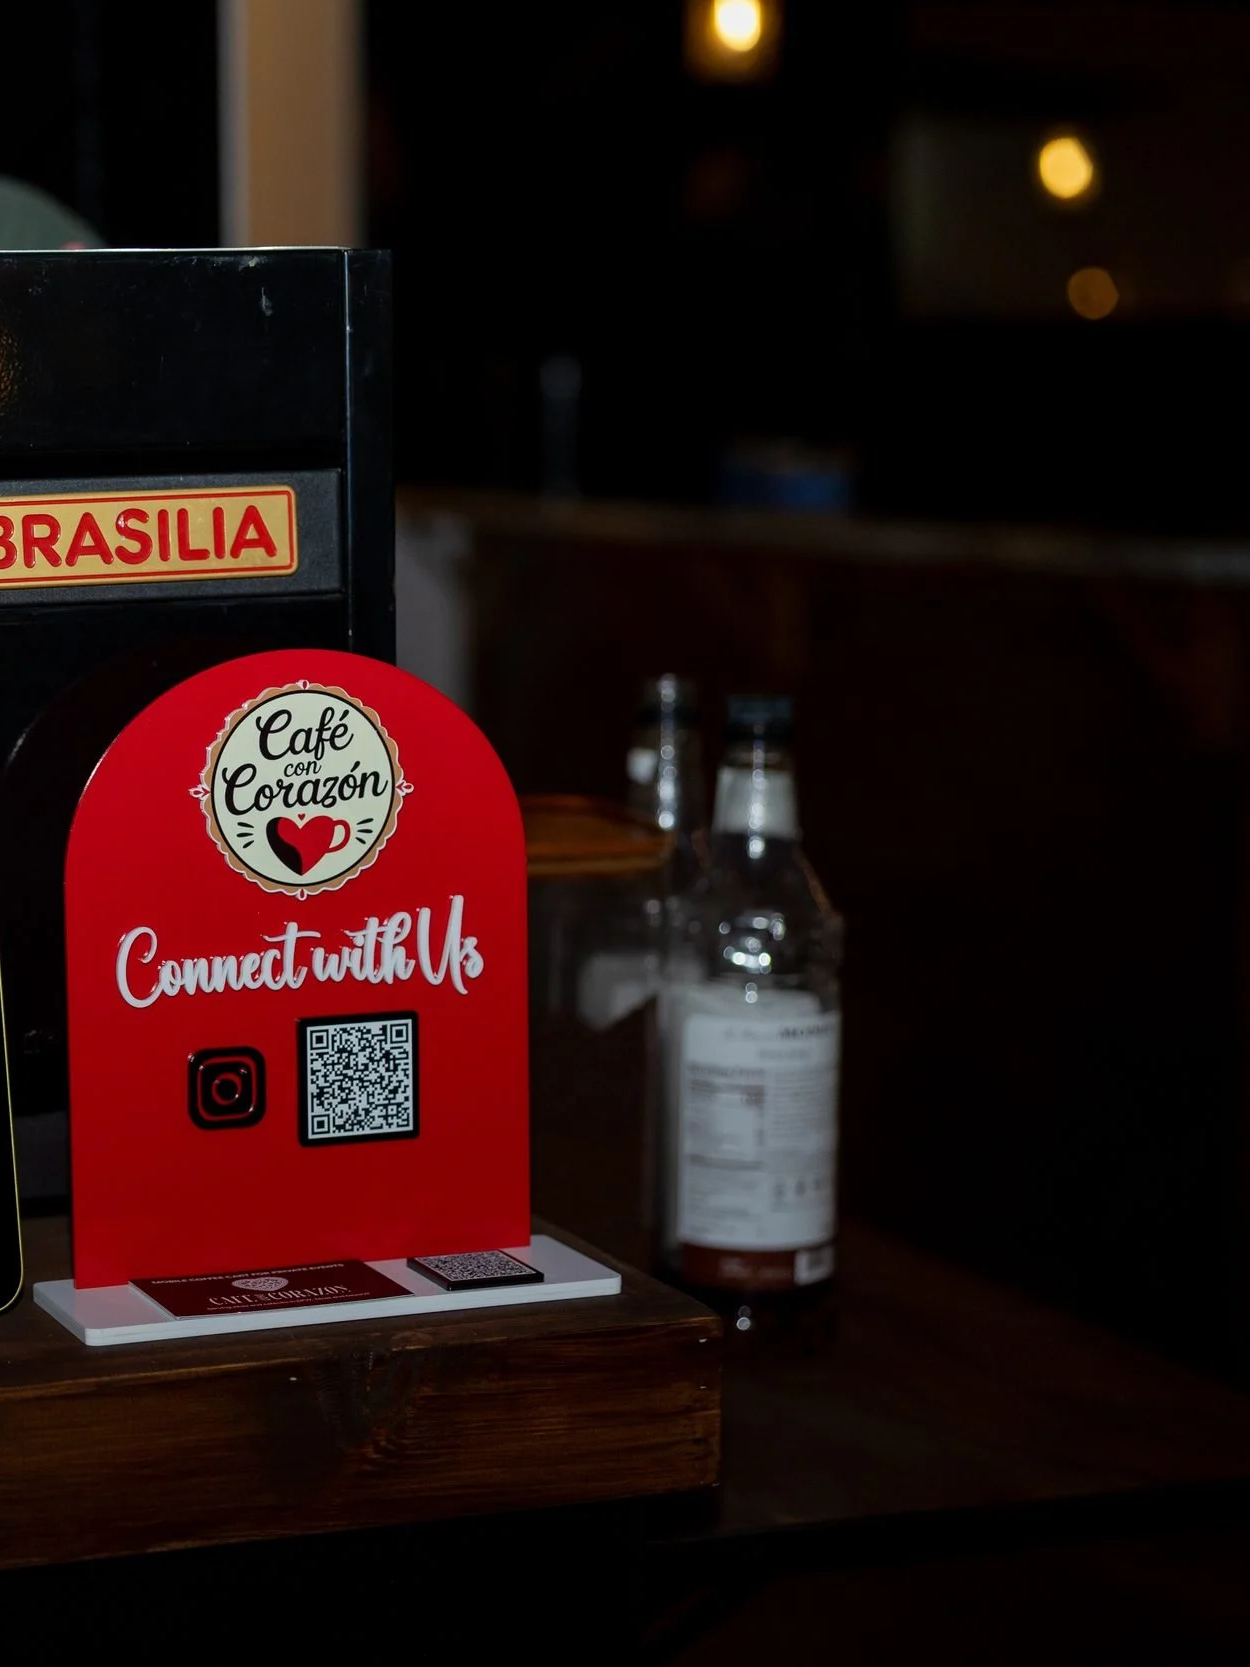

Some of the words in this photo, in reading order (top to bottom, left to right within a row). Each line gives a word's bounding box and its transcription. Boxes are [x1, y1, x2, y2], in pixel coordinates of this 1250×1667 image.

[254, 706, 354, 762] Café
[221, 760, 389, 816] Corazón
[283, 756, 323, 779] con
[116, 921, 322, 1009] Connect
[310, 910, 415, 986] with
[415, 894, 485, 996] Us
